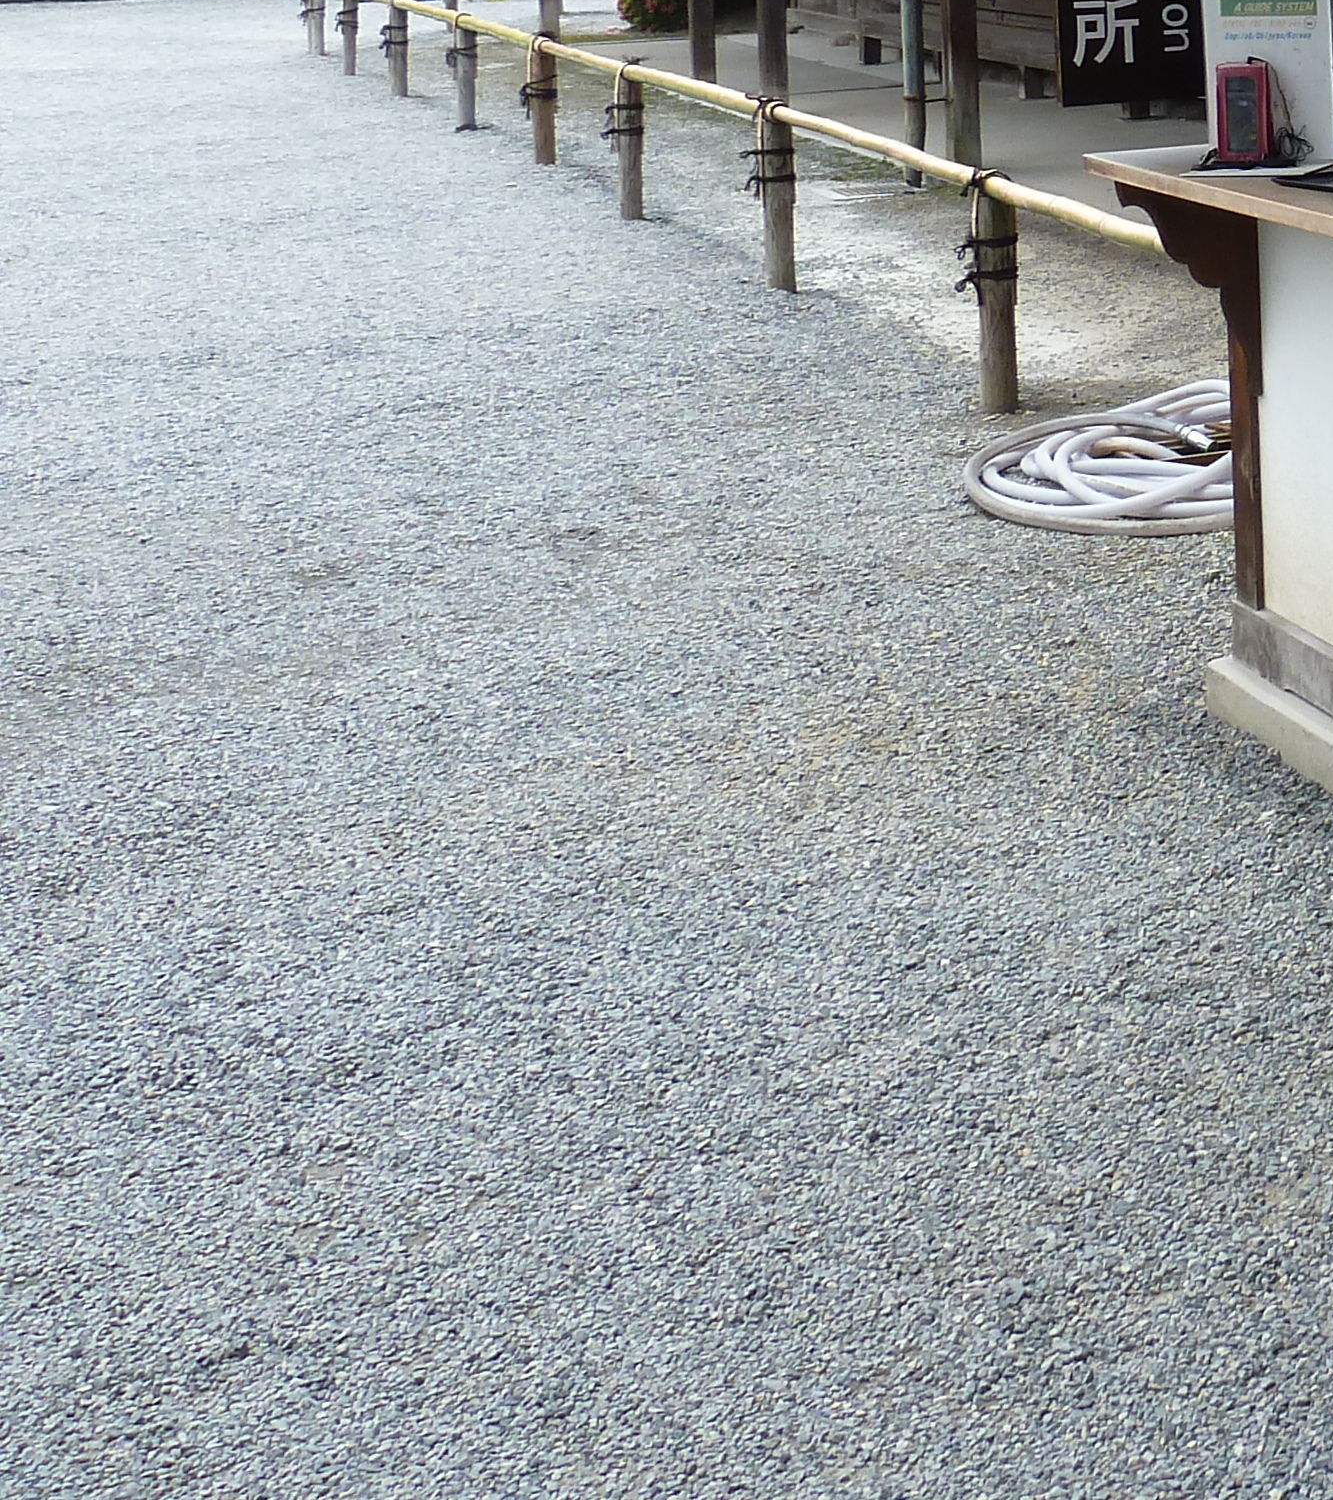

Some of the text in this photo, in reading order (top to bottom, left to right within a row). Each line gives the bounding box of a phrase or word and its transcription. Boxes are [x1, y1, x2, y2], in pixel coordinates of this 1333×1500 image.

[1234, 1, 1315, 13] A GUIDE SYSTEM
